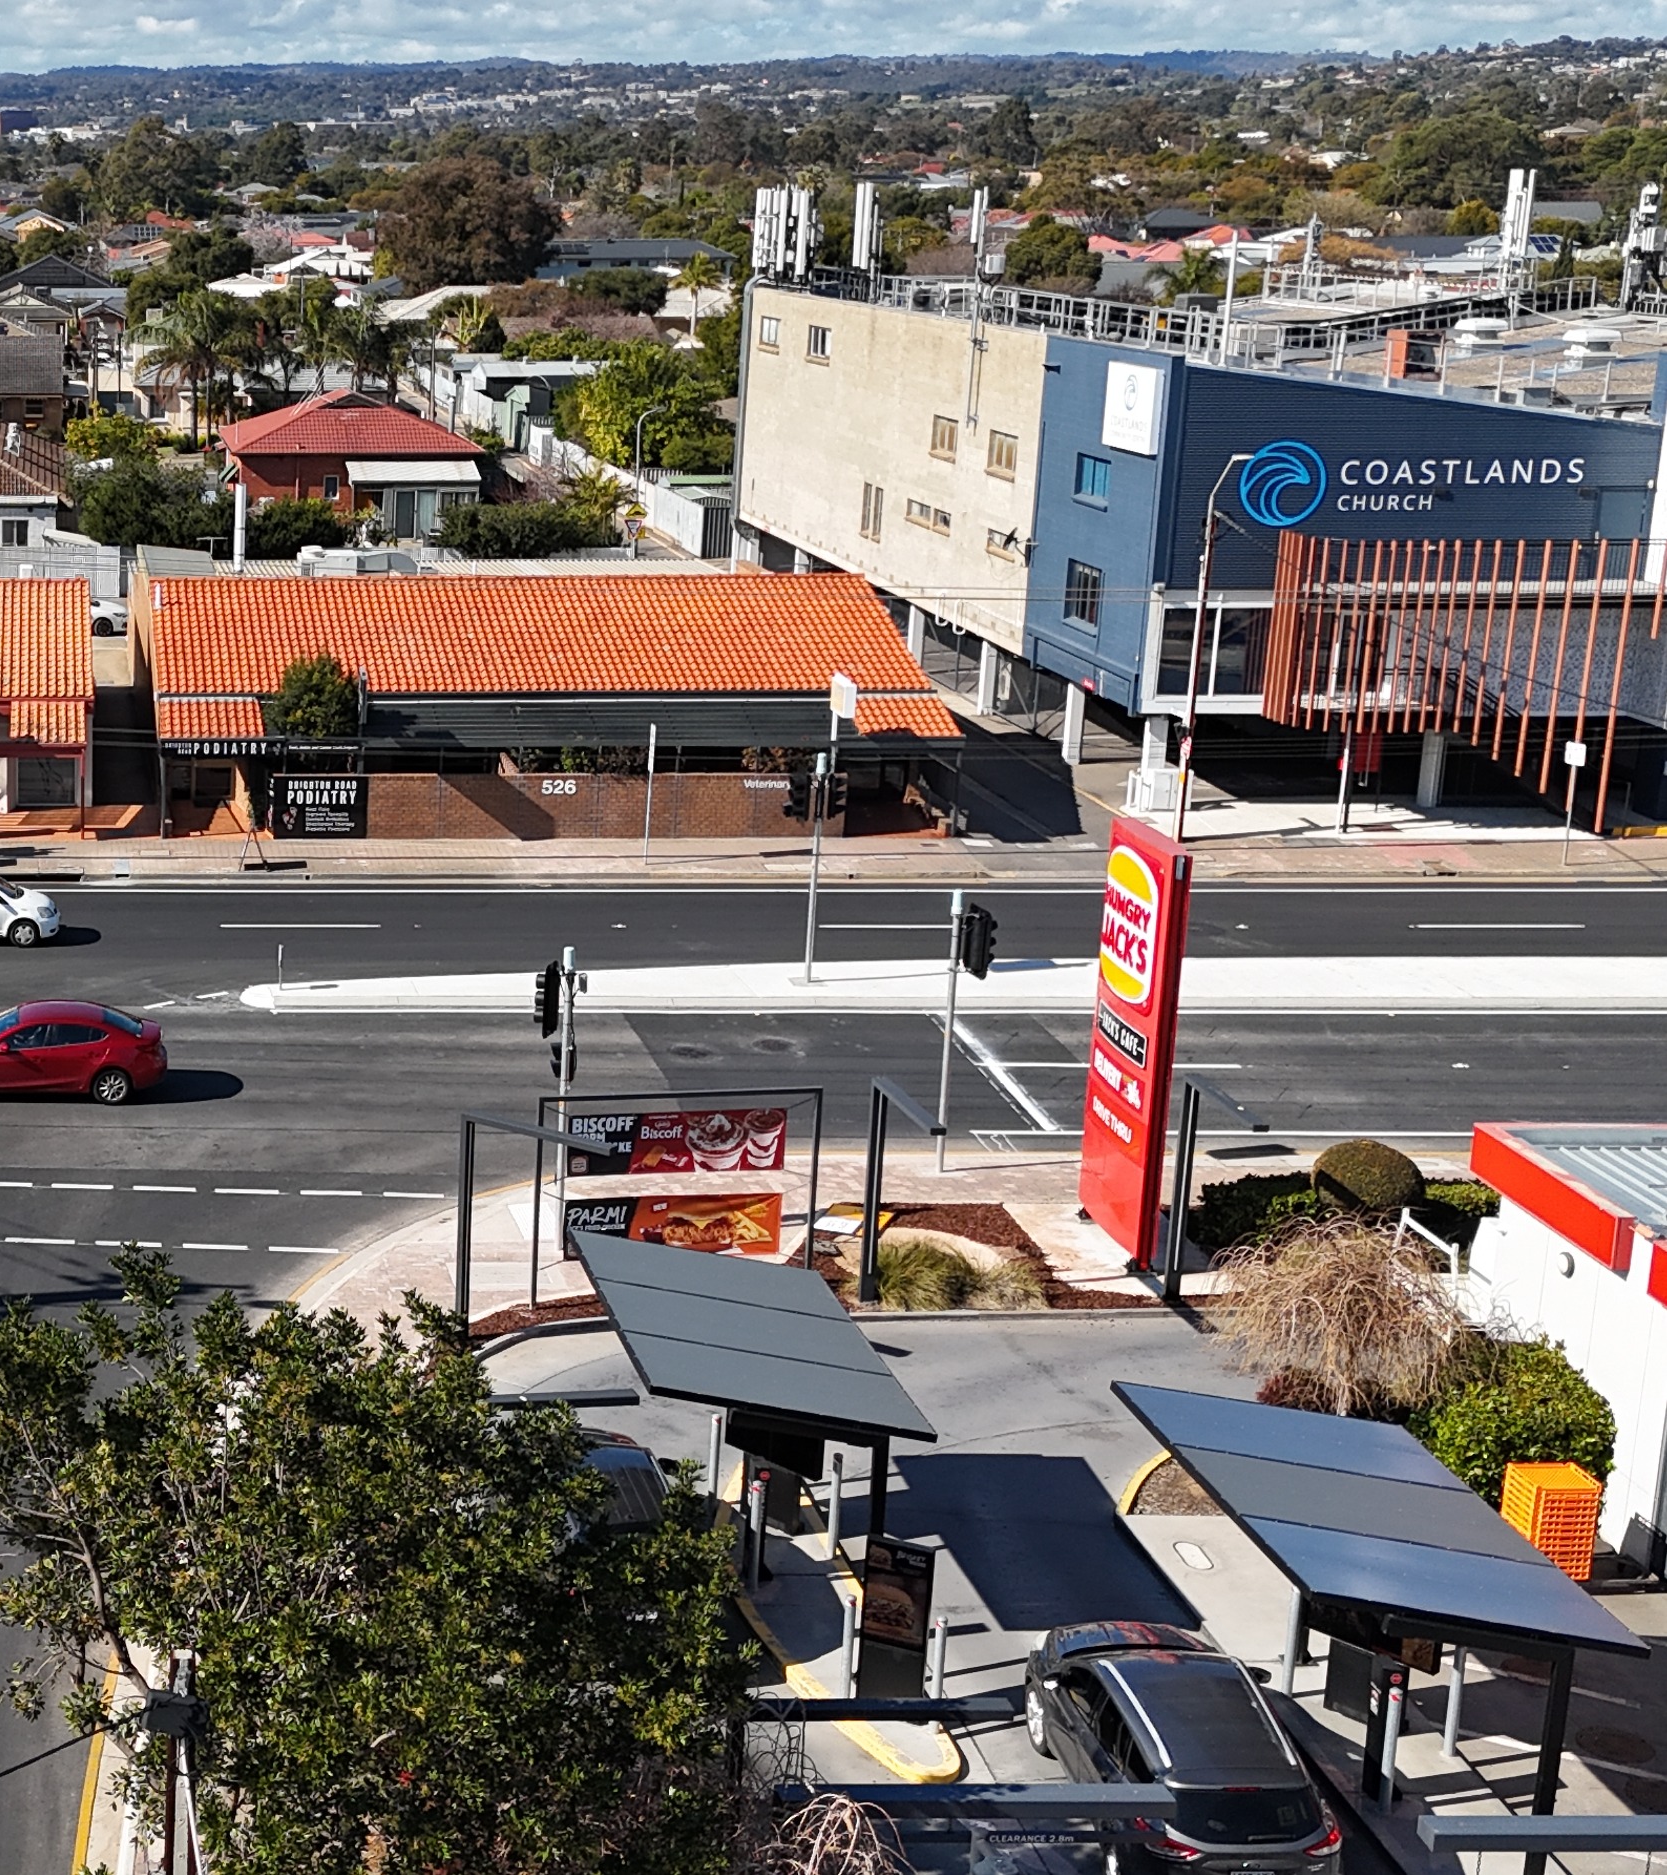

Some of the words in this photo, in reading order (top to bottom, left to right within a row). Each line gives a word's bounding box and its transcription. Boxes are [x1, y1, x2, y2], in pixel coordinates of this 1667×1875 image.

[1340, 458, 1585, 485] COASTLANDS
[1336, 494, 1433, 512] CHURCH
[193, 742, 267, 755] PODIATRY
[288, 780, 332, 790] BRIGHTON
[334, 780, 357, 790] ROAD
[541, 779, 577, 795] 526
[287, 790, 357, 804] PODIATRY
[1102, 882, 1151, 933] HUNGRY
[1100, 912, 1148, 975] JACK'S
[572, 1116, 634, 1134] BISCOFF
[640, 1125, 683, 1140] Biscoff
[1110, 1113, 1133, 1144] THRU
[566, 1205, 628, 1227] PARMI
[989, 1834, 1046, 1843] CLEARANCE
[1049, 1834, 1074, 1843] 2.8m
